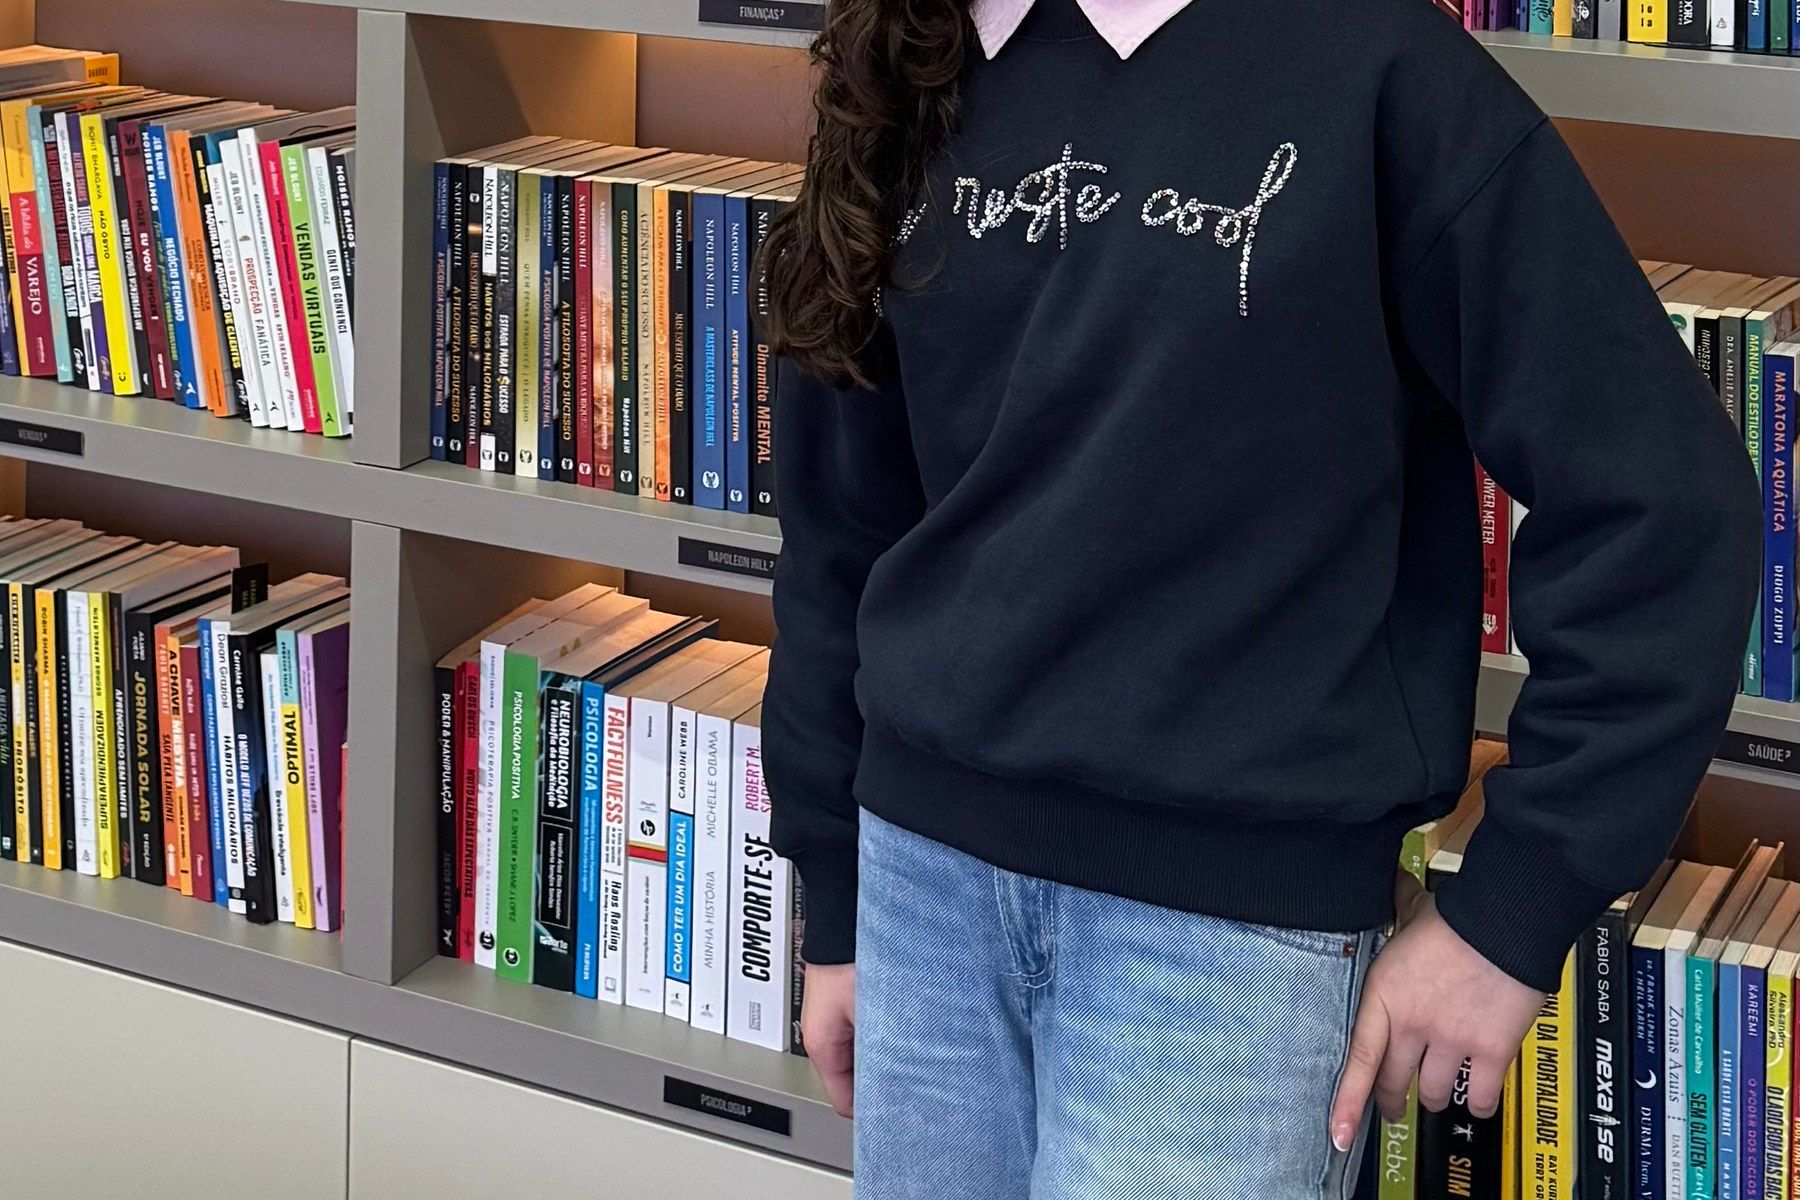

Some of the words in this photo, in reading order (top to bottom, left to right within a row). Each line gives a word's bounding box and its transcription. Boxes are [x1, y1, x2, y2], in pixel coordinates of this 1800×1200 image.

[294, 222, 315, 280] VENDAS
[705, 220, 715, 280] NAPOLEON
[26, 257, 42, 314] VAREJO
[705, 284, 715, 309] HILL
[244, 258, 263, 314] PROSPECÇÃO
[254, 319, 272, 366] FANÁTICA
[302, 287, 327, 354] VIRTUAIS
[757, 345, 769, 402] Dinamite
[1748, 334, 1760, 379] MANUAL
[1748, 383, 1760, 399] DO
[1772, 371, 1788, 453] MARATONA
[757, 406, 771, 464] MENTAL
[1748, 402, 1760, 440] ESTILO
[1748, 442, 1759, 456] DE
[1772, 458, 1787, 532] AQUÁTICA
[1482, 510, 1495, 544] METER
[1773, 565, 1784, 602] DIOGO
[1773, 607, 1784, 644] ZOPPI
[134, 671, 151, 757] JORNADA
[511, 691, 524, 751] PSICOLOGIA
[282, 710, 300, 784] OPTIMAL
[556, 700, 571, 808] NEUROBIOLOGIA
[585, 697, 602, 790] PSICOLOGIA
[605, 707, 626, 823] FACTFULNESS
[707, 731, 718, 775] OBAMA
[137, 761, 152, 822] SOLAR
[510, 753, 523, 798] POSITIVA
[706, 779, 718, 837] MICHELLE
[674, 820, 686, 855] IDEAL
[673, 859, 685, 880] DIA
[673, 882, 685, 901] UM
[609, 880, 622, 907] Hans
[673, 906, 685, 926] TER
[703, 871, 716, 924] HISTÓRIA
[742, 832, 774, 981] COMPORTE-SE
[608, 910, 621, 951] Rosling
[672, 930, 685, 972] COMO
[703, 929, 715, 968] MINHA
[1597, 927, 1609, 974] FABIO
[1597, 980, 1610, 1023] SABA
[1748, 984, 1760, 1036] KAREEMI
[1536, 1023, 1558, 1040] DA
[1669, 1005, 1684, 1054] Zonas
[1536, 1045, 1558, 1147] IMORTALIDADE
[1669, 1059, 1684, 1102] Azuis
[1690, 1092, 1708, 1118] SEM
[1386, 1123, 1410, 1182] Bebé
[1690, 1121, 1709, 1168] GLÚTEN
